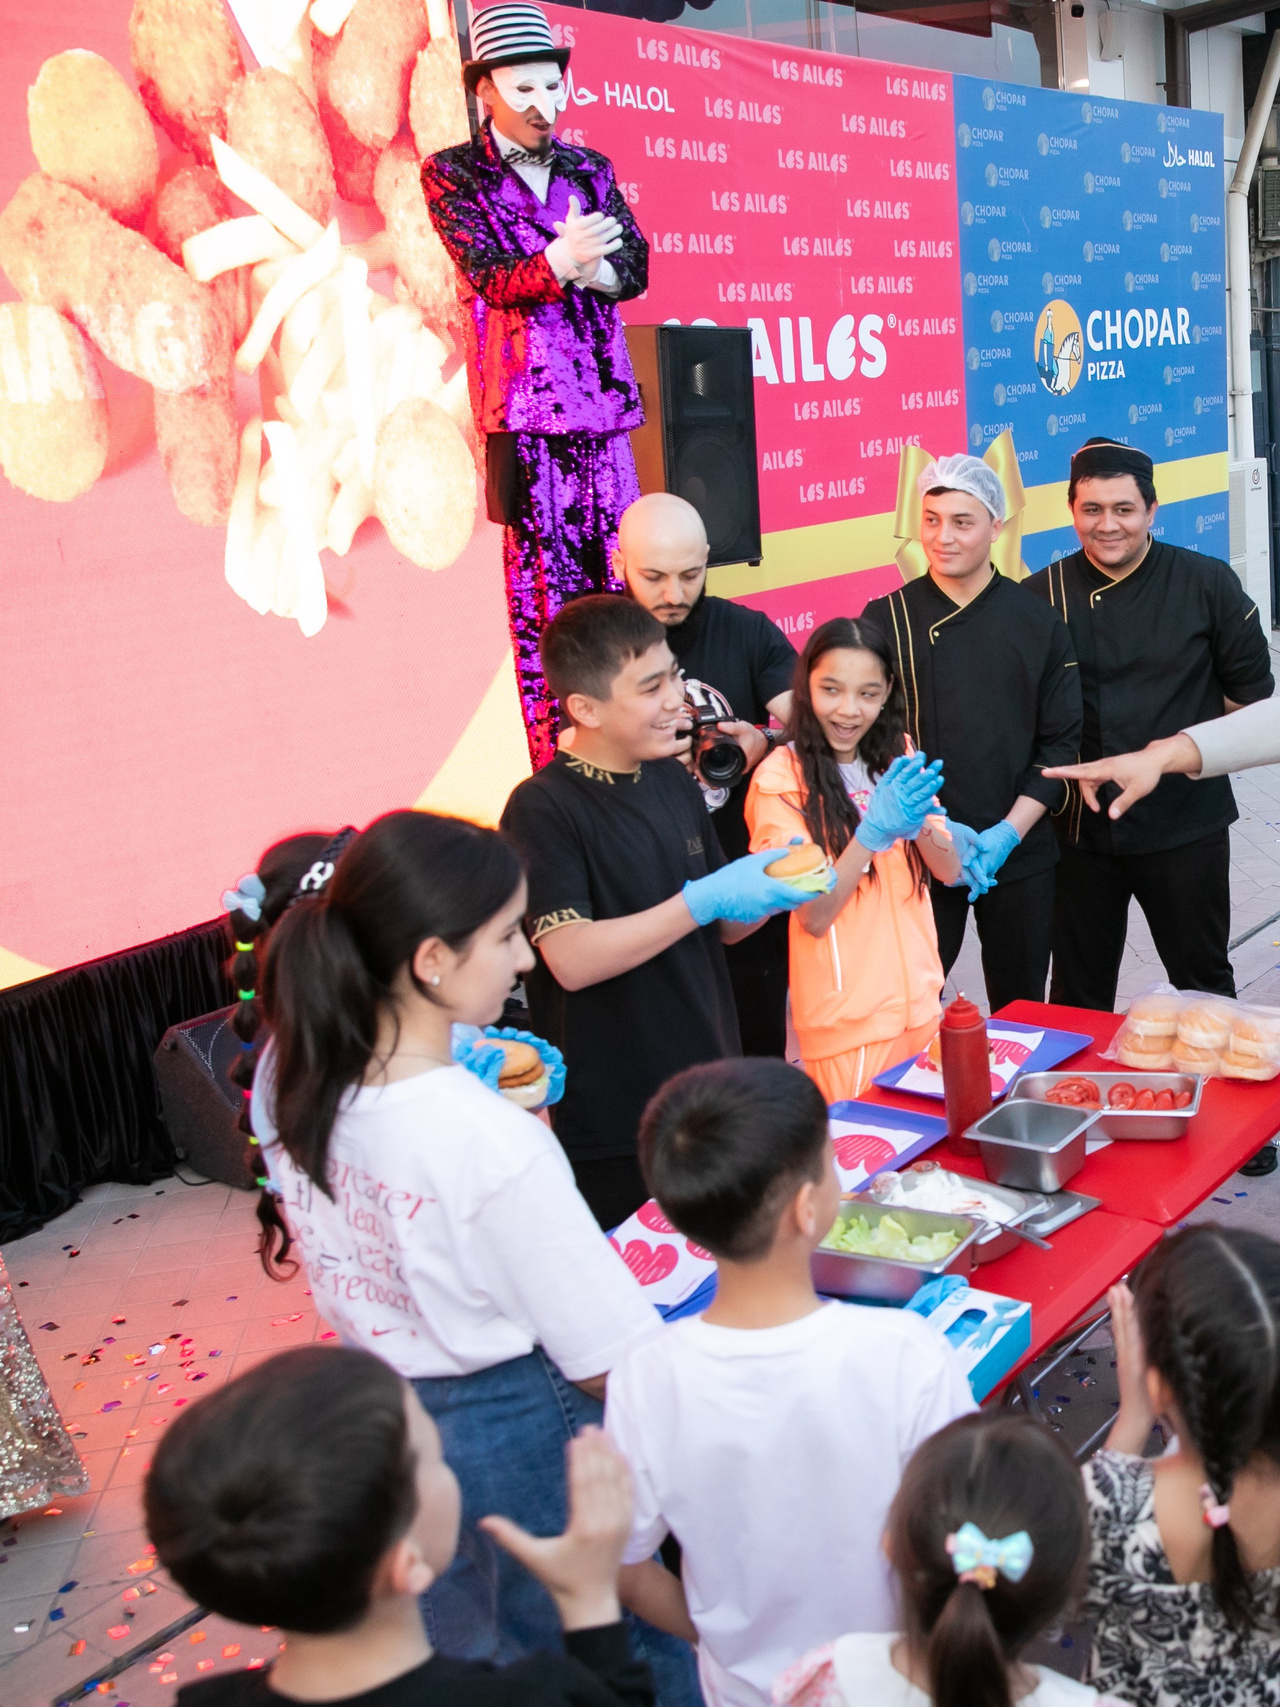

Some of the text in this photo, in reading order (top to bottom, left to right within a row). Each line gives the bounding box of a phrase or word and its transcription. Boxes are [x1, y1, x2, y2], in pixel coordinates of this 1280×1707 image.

[604, 81, 675, 113] HALOL
[996, 92, 1026, 106] CHOPAR
[1093, 106, 1119, 118] CHOPAR
[1167, 116, 1190, 128] CHOPAR
[972, 128, 1003, 141] CHOPAR
[1050, 137, 1077, 149] CHOPAR
[1132, 146, 1156, 157] CHOPAR
[1188, 150, 1215, 167] HALOL
[999, 168, 1029, 180] CHOPAR
[1095, 176, 1120, 186] CHOPAR
[1169, 181, 1191, 192] CHOPAR
[975, 205, 1006, 217] CHOPAR
[1052, 209, 1080, 220] CHOPAR
[1133, 213, 1157, 223] CHOPAR
[1199, 216, 1220, 225] CHOPAR
[1002, 242, 1031, 252] CHOPAR
[1095, 244, 1120, 254] CHOPAR
[1170, 245, 1192, 254] CHOPAR
[978, 275, 1008, 285] CHOPAR
[1054, 275, 1082, 285] CHOPAR
[1135, 274, 1159, 283] CHOPAR
[1200, 274, 1221, 282] CHOPAR
[1004, 312, 1033, 323] CHOPAR
[1086, 308, 1190, 351] CHOPAR
[1202, 326, 1222, 336] CHOPAR
[980, 348, 1011, 360] CHOPAR
[1088, 360, 1125, 381] PIZZA
[1173, 366, 1195, 376] CHOPAR
[1007, 383, 1036, 396] CHOPAR
[1203, 396, 1223, 407] CHOPAR
[1139, 404, 1162, 415] CHOPAR
[1059, 413, 1086, 425] CHOPAR
[1174, 426, 1196, 437] CHOPAR
[1204, 512, 1225, 525] CHOPAR
